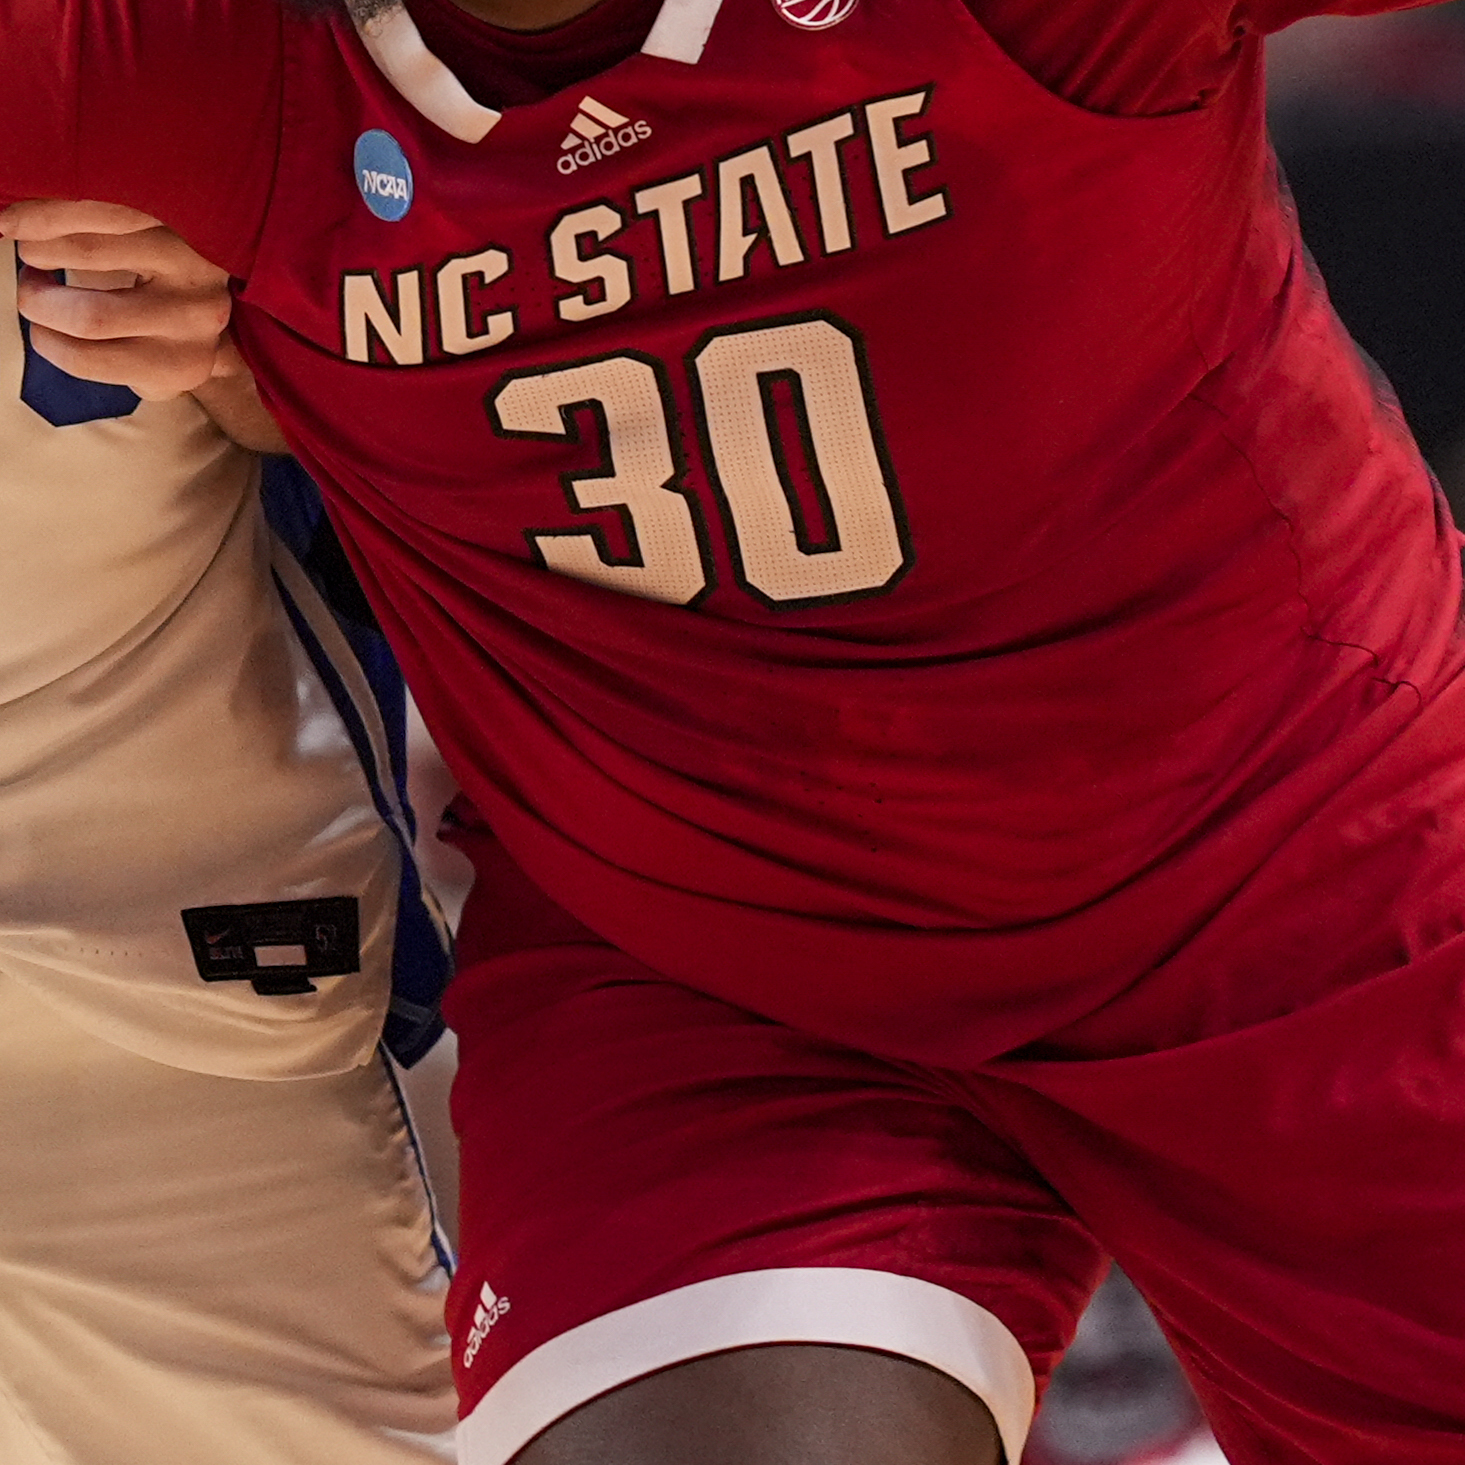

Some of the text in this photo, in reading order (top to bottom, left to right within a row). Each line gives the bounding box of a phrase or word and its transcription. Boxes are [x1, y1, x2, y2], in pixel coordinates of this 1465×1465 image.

[556, 119, 653, 175] adidas
[361, 169, 409, 202] NCAA
[339, 85, 952, 368] NC STATE
[485, 309, 916, 613] 30
[462, 1296, 511, 1369] adidas
